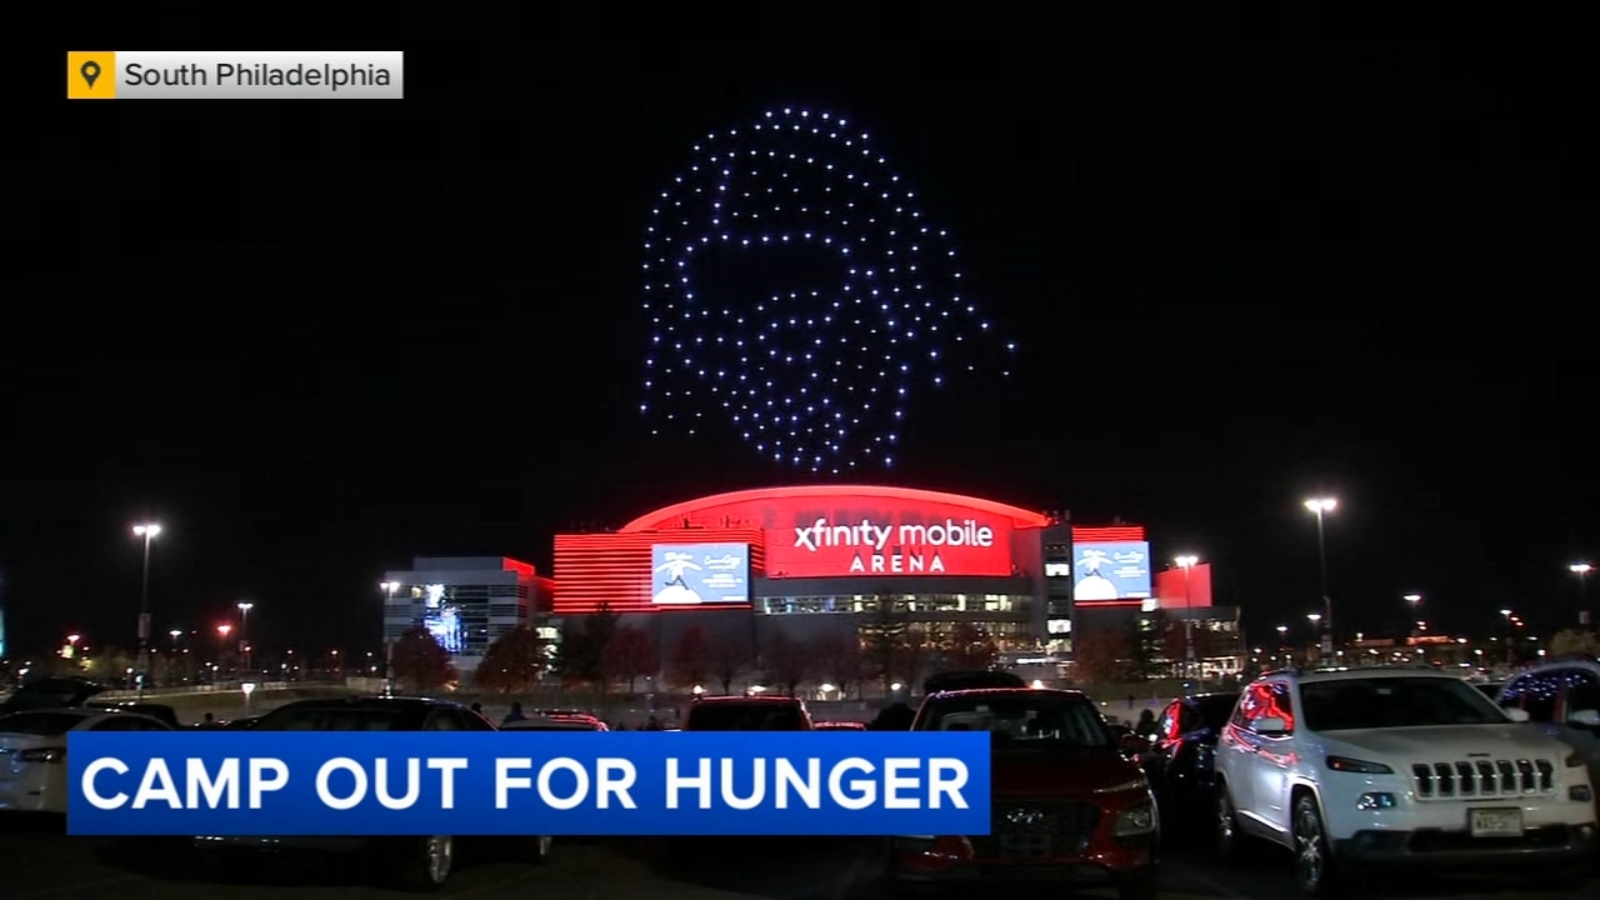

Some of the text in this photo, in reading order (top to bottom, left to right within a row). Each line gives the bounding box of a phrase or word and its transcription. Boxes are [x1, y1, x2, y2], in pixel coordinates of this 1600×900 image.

[794, 518, 993, 551] xfinity mobile
[850, 555, 945, 573] ARENA
